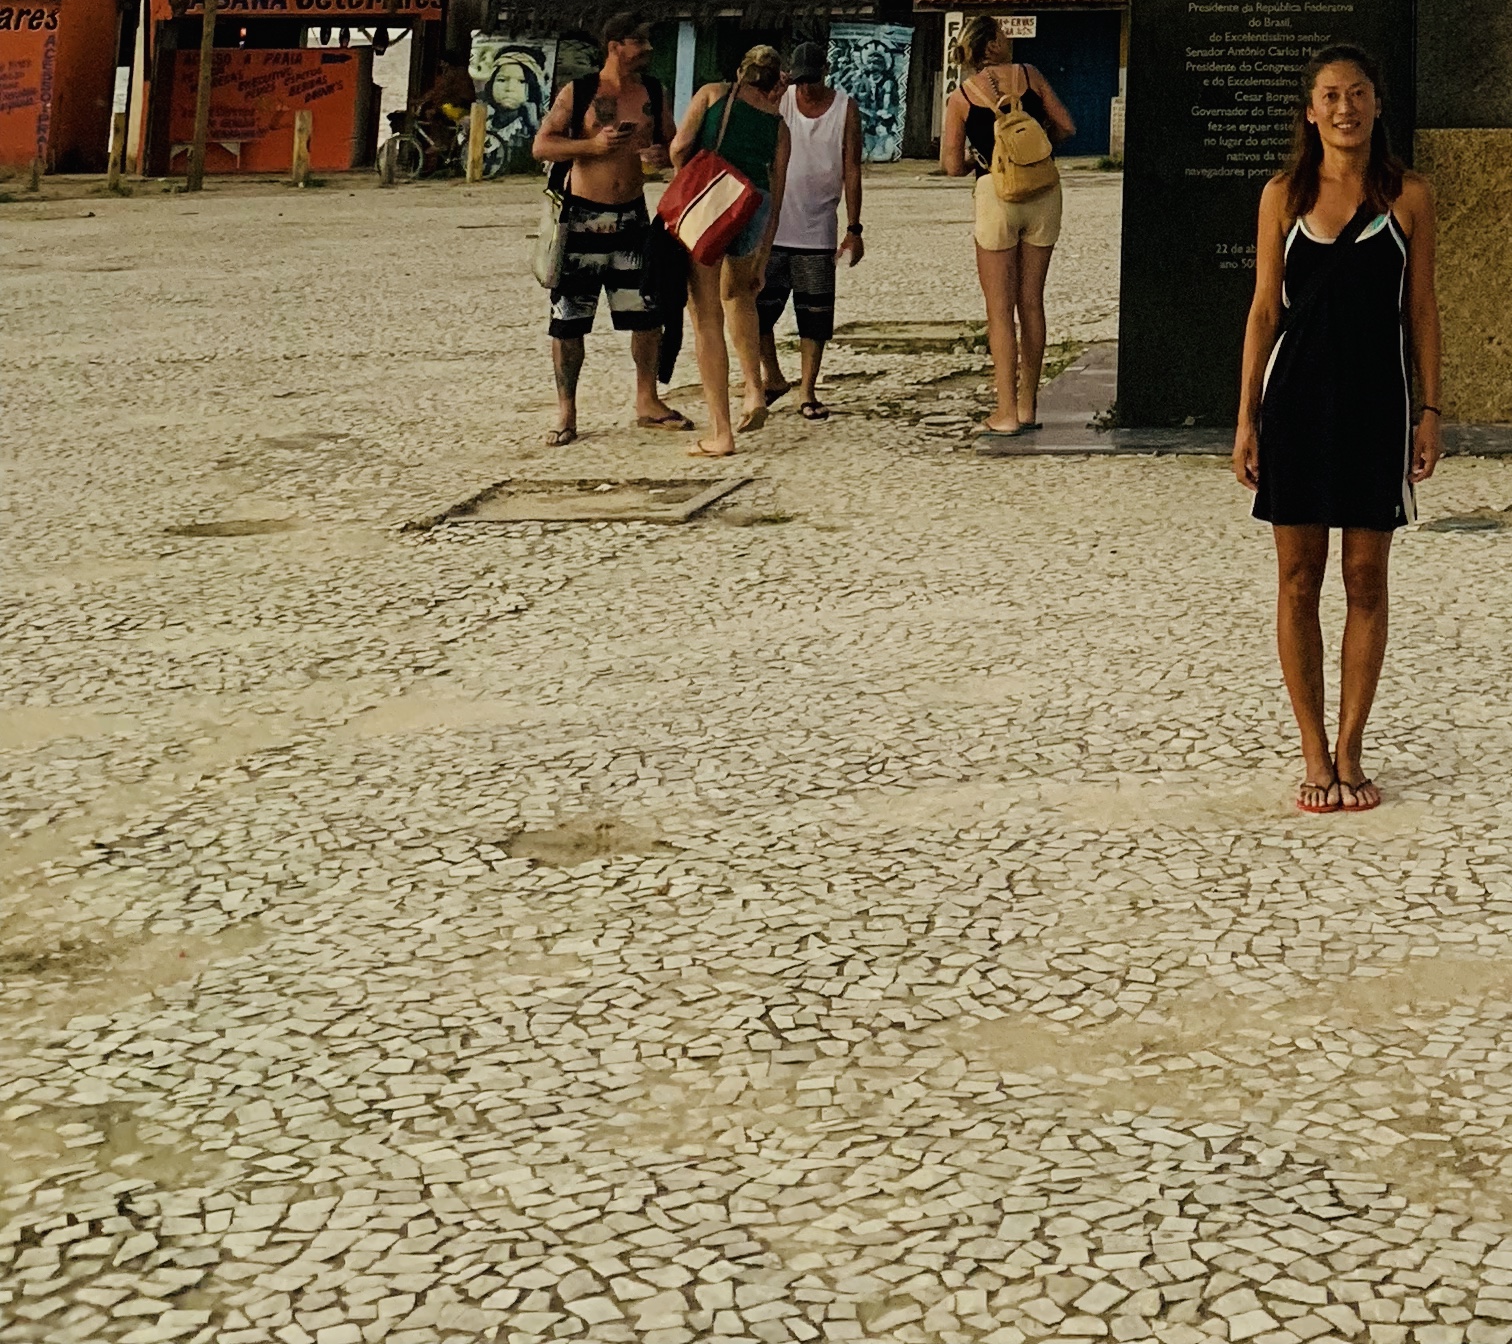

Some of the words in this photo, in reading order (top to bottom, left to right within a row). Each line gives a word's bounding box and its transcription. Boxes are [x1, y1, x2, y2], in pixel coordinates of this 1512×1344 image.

[1188, 2, 1239, 12] Presidente
[1241, 4, 1253, 13] da
[0, 6, 59, 31] ares
[1248, 17, 1262, 27] do
[1209, 32, 1222, 42] do
[1185, 47, 1225, 57] Senador
[1268, 46, 1299, 56] Carlos
[1185, 61, 1236, 72] Presidente
[1238, 61, 1252, 72] do
[1211, 77, 1225, 86] do
[1191, 105, 1249, 116] Governador
[1251, 107, 1264, 116] do
[1207, 121, 1237, 131] fez-se
[1238, 124, 1271, 134] erguer
[1203, 137, 1217, 146] no
[1219, 136, 1243, 148] lugar
[1245, 136, 1258, 146] do
[1226, 153, 1260, 161] nativos
[1263, 151, 1275, 161] da
[1184, 166, 1245, 178] navegadores
[1215, 244, 1228, 253] 22
[1230, 244, 1243, 254] de
[1219, 261, 1239, 269] ano
